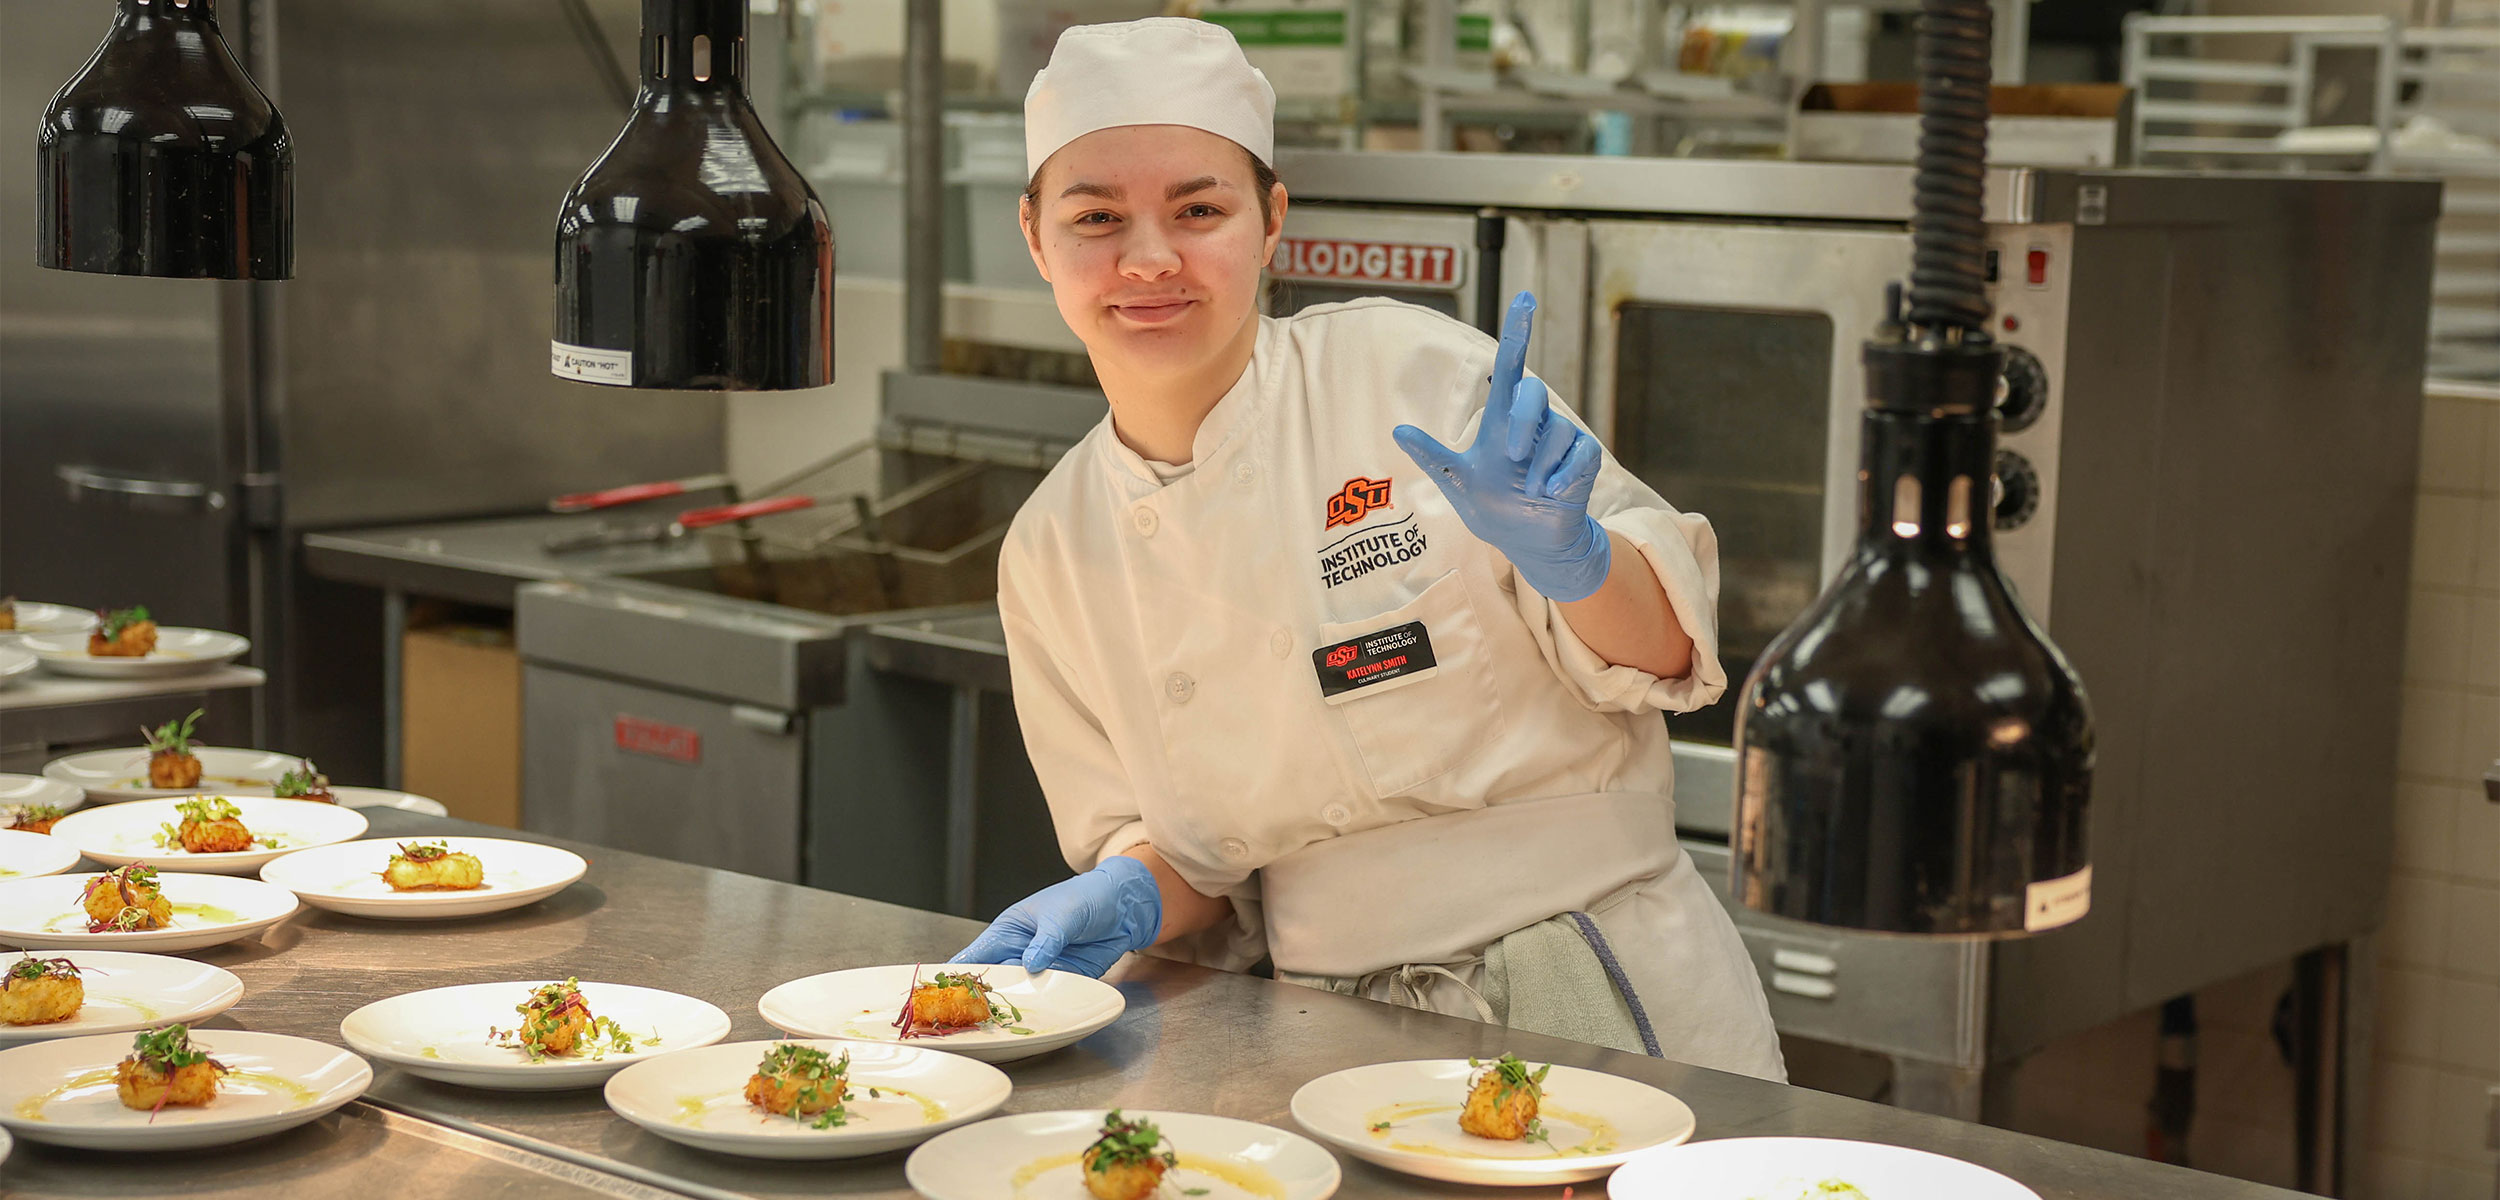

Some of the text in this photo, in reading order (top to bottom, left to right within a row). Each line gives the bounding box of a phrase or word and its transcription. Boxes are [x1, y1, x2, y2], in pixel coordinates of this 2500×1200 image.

[1273, 242, 1450, 283] BLODGETT
[572, 358, 596, 368] CAUTION
[1325, 476, 1392, 532] OSU
[1321, 523, 1419, 573] INSTITUTE OF
[1321, 534, 1428, 589] TECHNOLOGY
[1365, 631, 1412, 649] INSTITUTE OF
[1367, 636, 1418, 656] TECHNOLOGY
[1326, 645, 1358, 667] OSU
[1346, 655, 1408, 680] KATELYNN SMITH
[1358, 668, 1401, 684] CULINARY STUDENT
